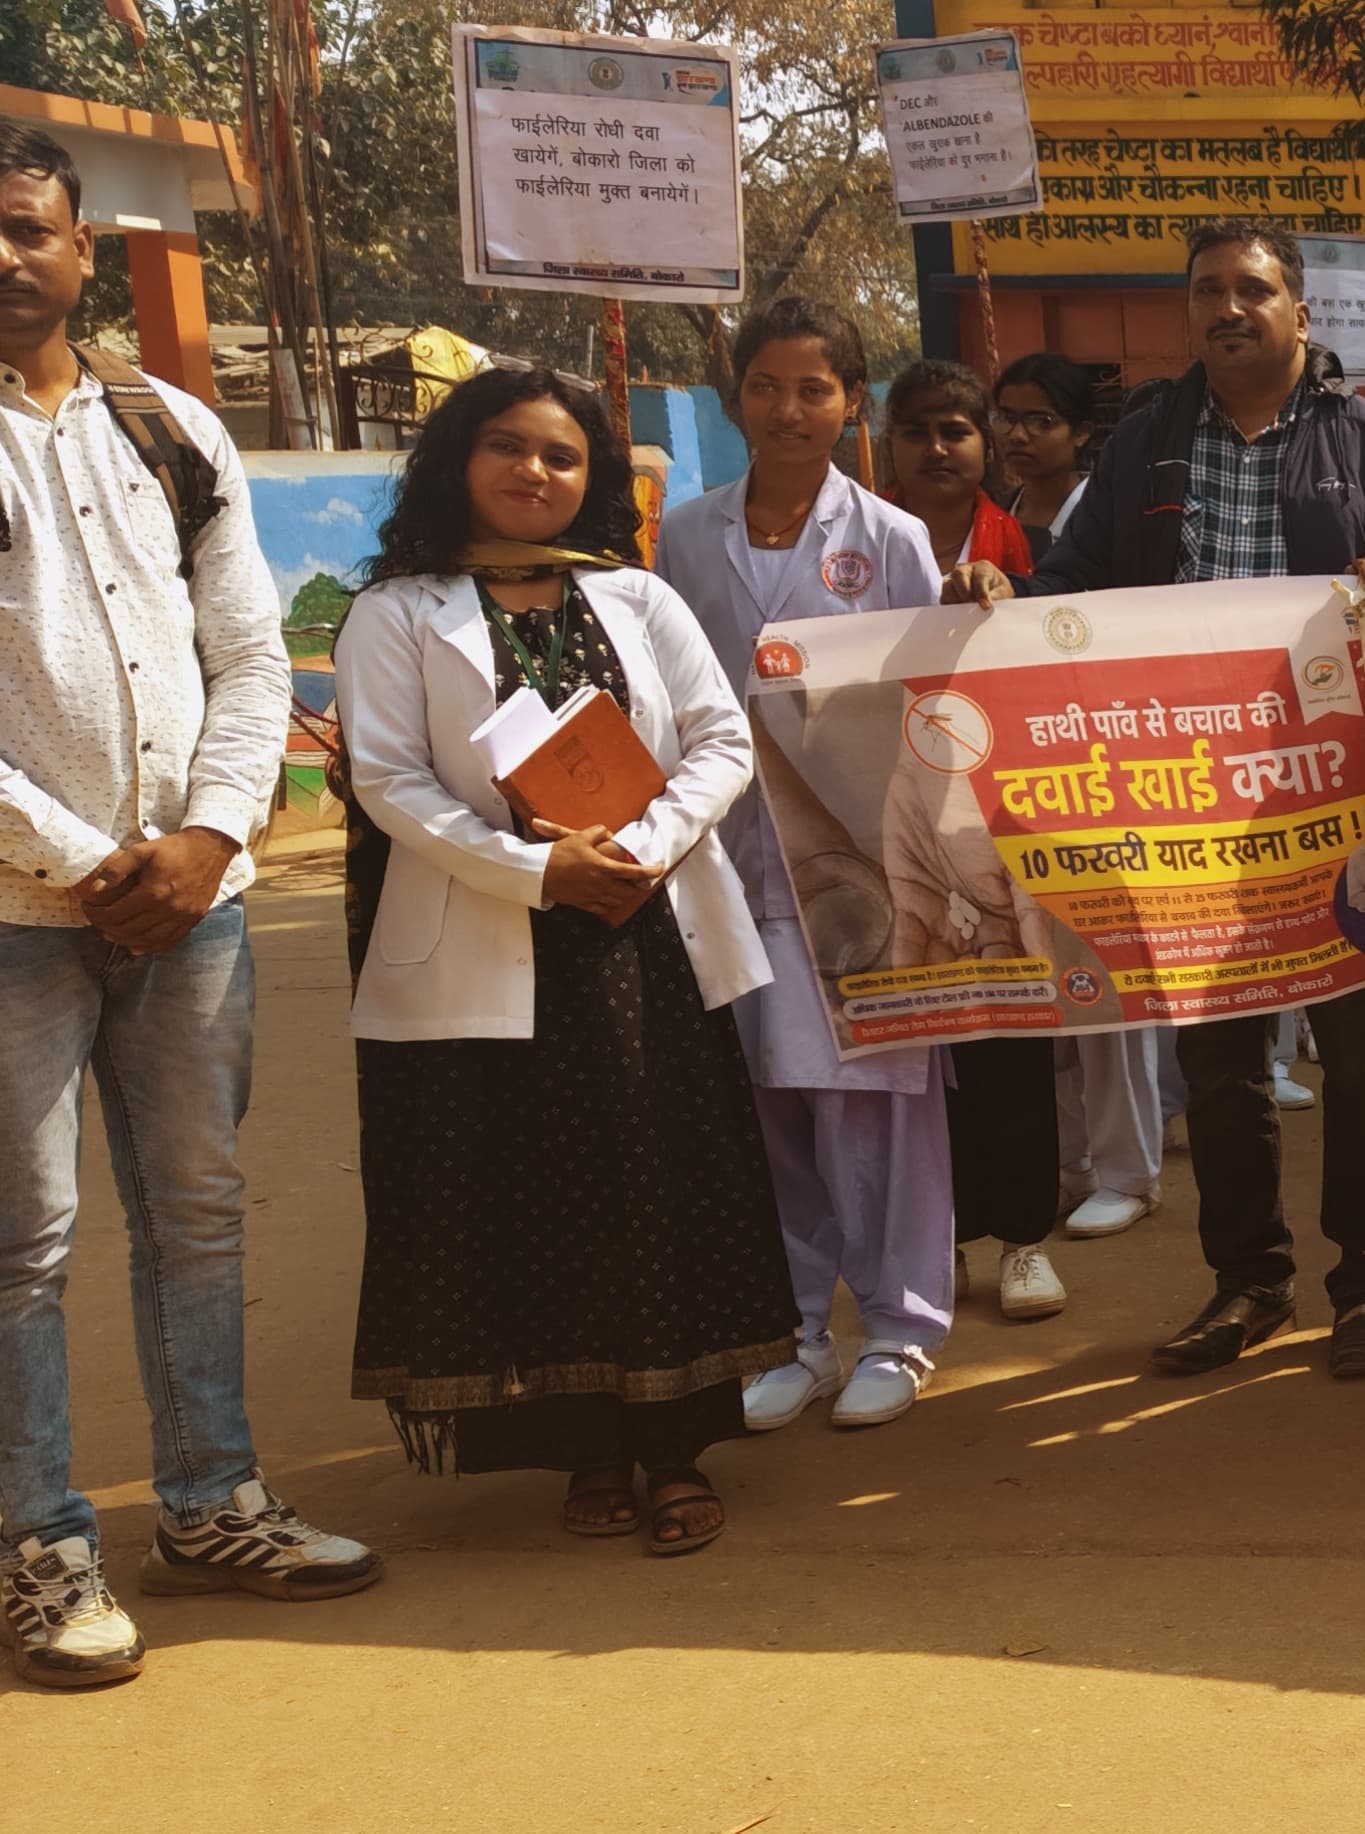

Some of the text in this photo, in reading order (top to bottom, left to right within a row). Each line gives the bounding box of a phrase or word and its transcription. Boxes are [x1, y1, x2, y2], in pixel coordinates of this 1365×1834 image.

[900, 97, 922, 110] DEC
[511, 113, 660, 142] फाईलेरिया रोधी दवा
[903, 113, 981, 132] ALBENDAZOLE
[570, 149, 621, 171] बोकारो
[628, 152, 668, 173] जिला
[675, 153, 696, 174] को
[1160, 138, 1193, 162] का
[1196, 137, 1264, 167] मतलब
[515, 175, 590, 199] फाईलेरिया
[599, 183, 632, 204] मुक्त
[1221, 175, 1272, 208] रहना
[1132, 213, 1164, 241] का
[1025, 690, 1288, 747] हाथी पाँव से बचाव की
[993, 739, 1347, 819] दवाई खाई क्या?
[1019, 848, 1049, 880] 10
[1054, 830, 1149, 876] फरवरी
[1154, 838, 1208, 872] याद
[1210, 829, 1291, 864] रखना
[1144, 996, 1179, 1013] जिला
[1288, 973, 1334, 995] बोकारो
